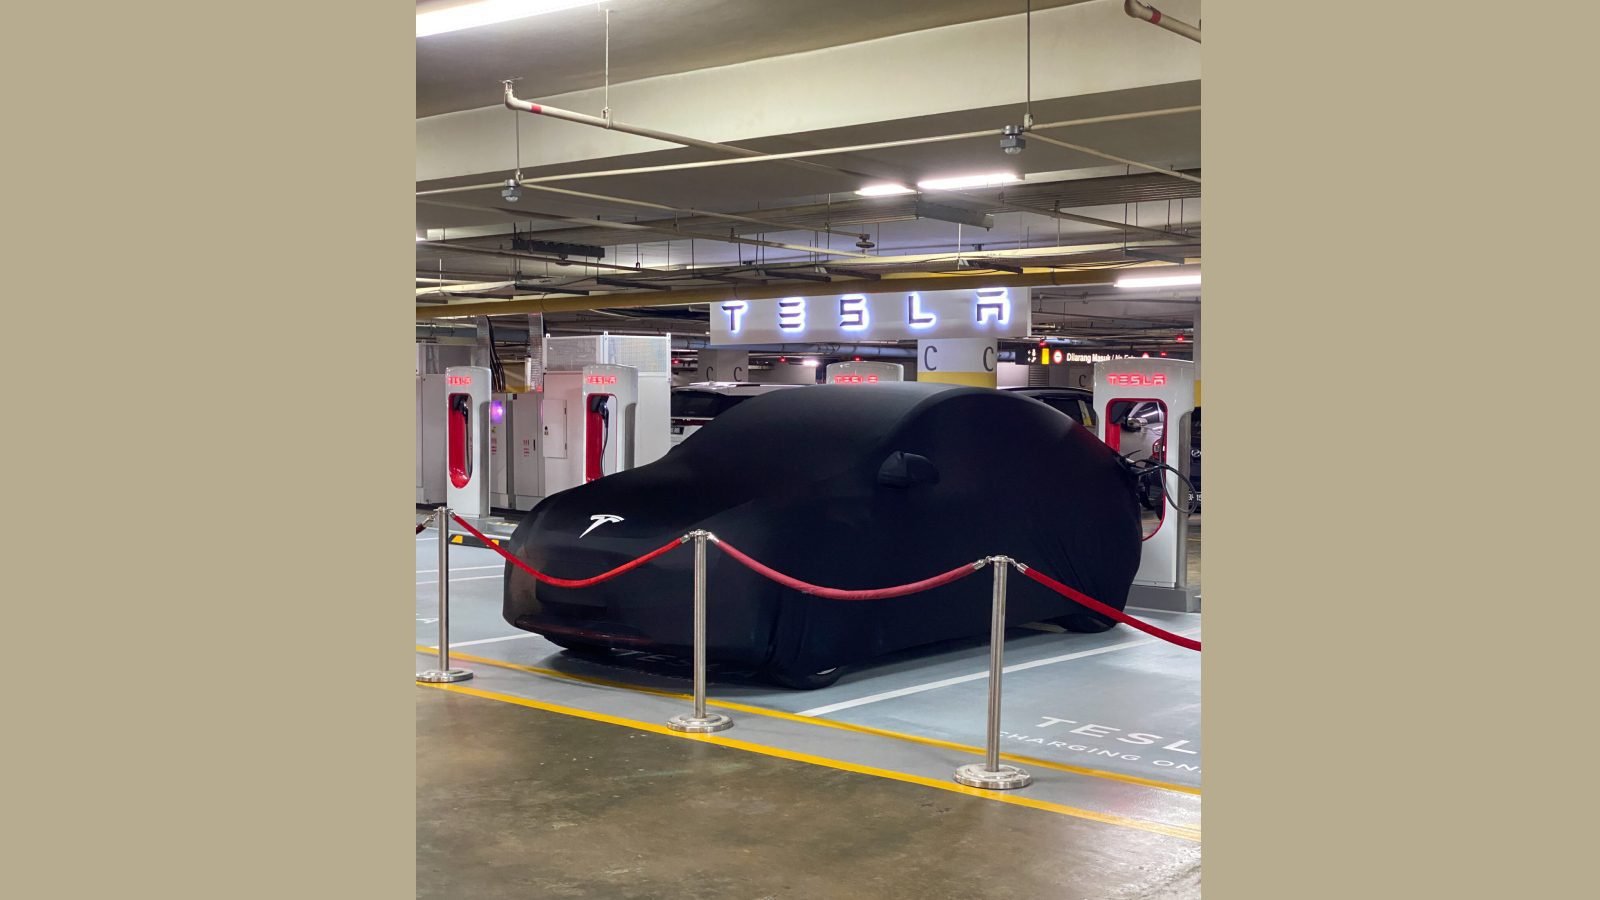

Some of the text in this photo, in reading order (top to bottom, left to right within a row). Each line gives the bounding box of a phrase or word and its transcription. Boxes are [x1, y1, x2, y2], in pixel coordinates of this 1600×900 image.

[721, 289, 1008, 332] TESLA
[924, 345, 937, 371] C
[983, 346, 994, 372] C
[1066, 353, 1091, 363] Dilarang
[733, 366, 743, 382] C
[1078, 374, 1087, 388] C
[1108, 374, 1166, 386] TESLA
[1152, 760, 1201, 774] ON
